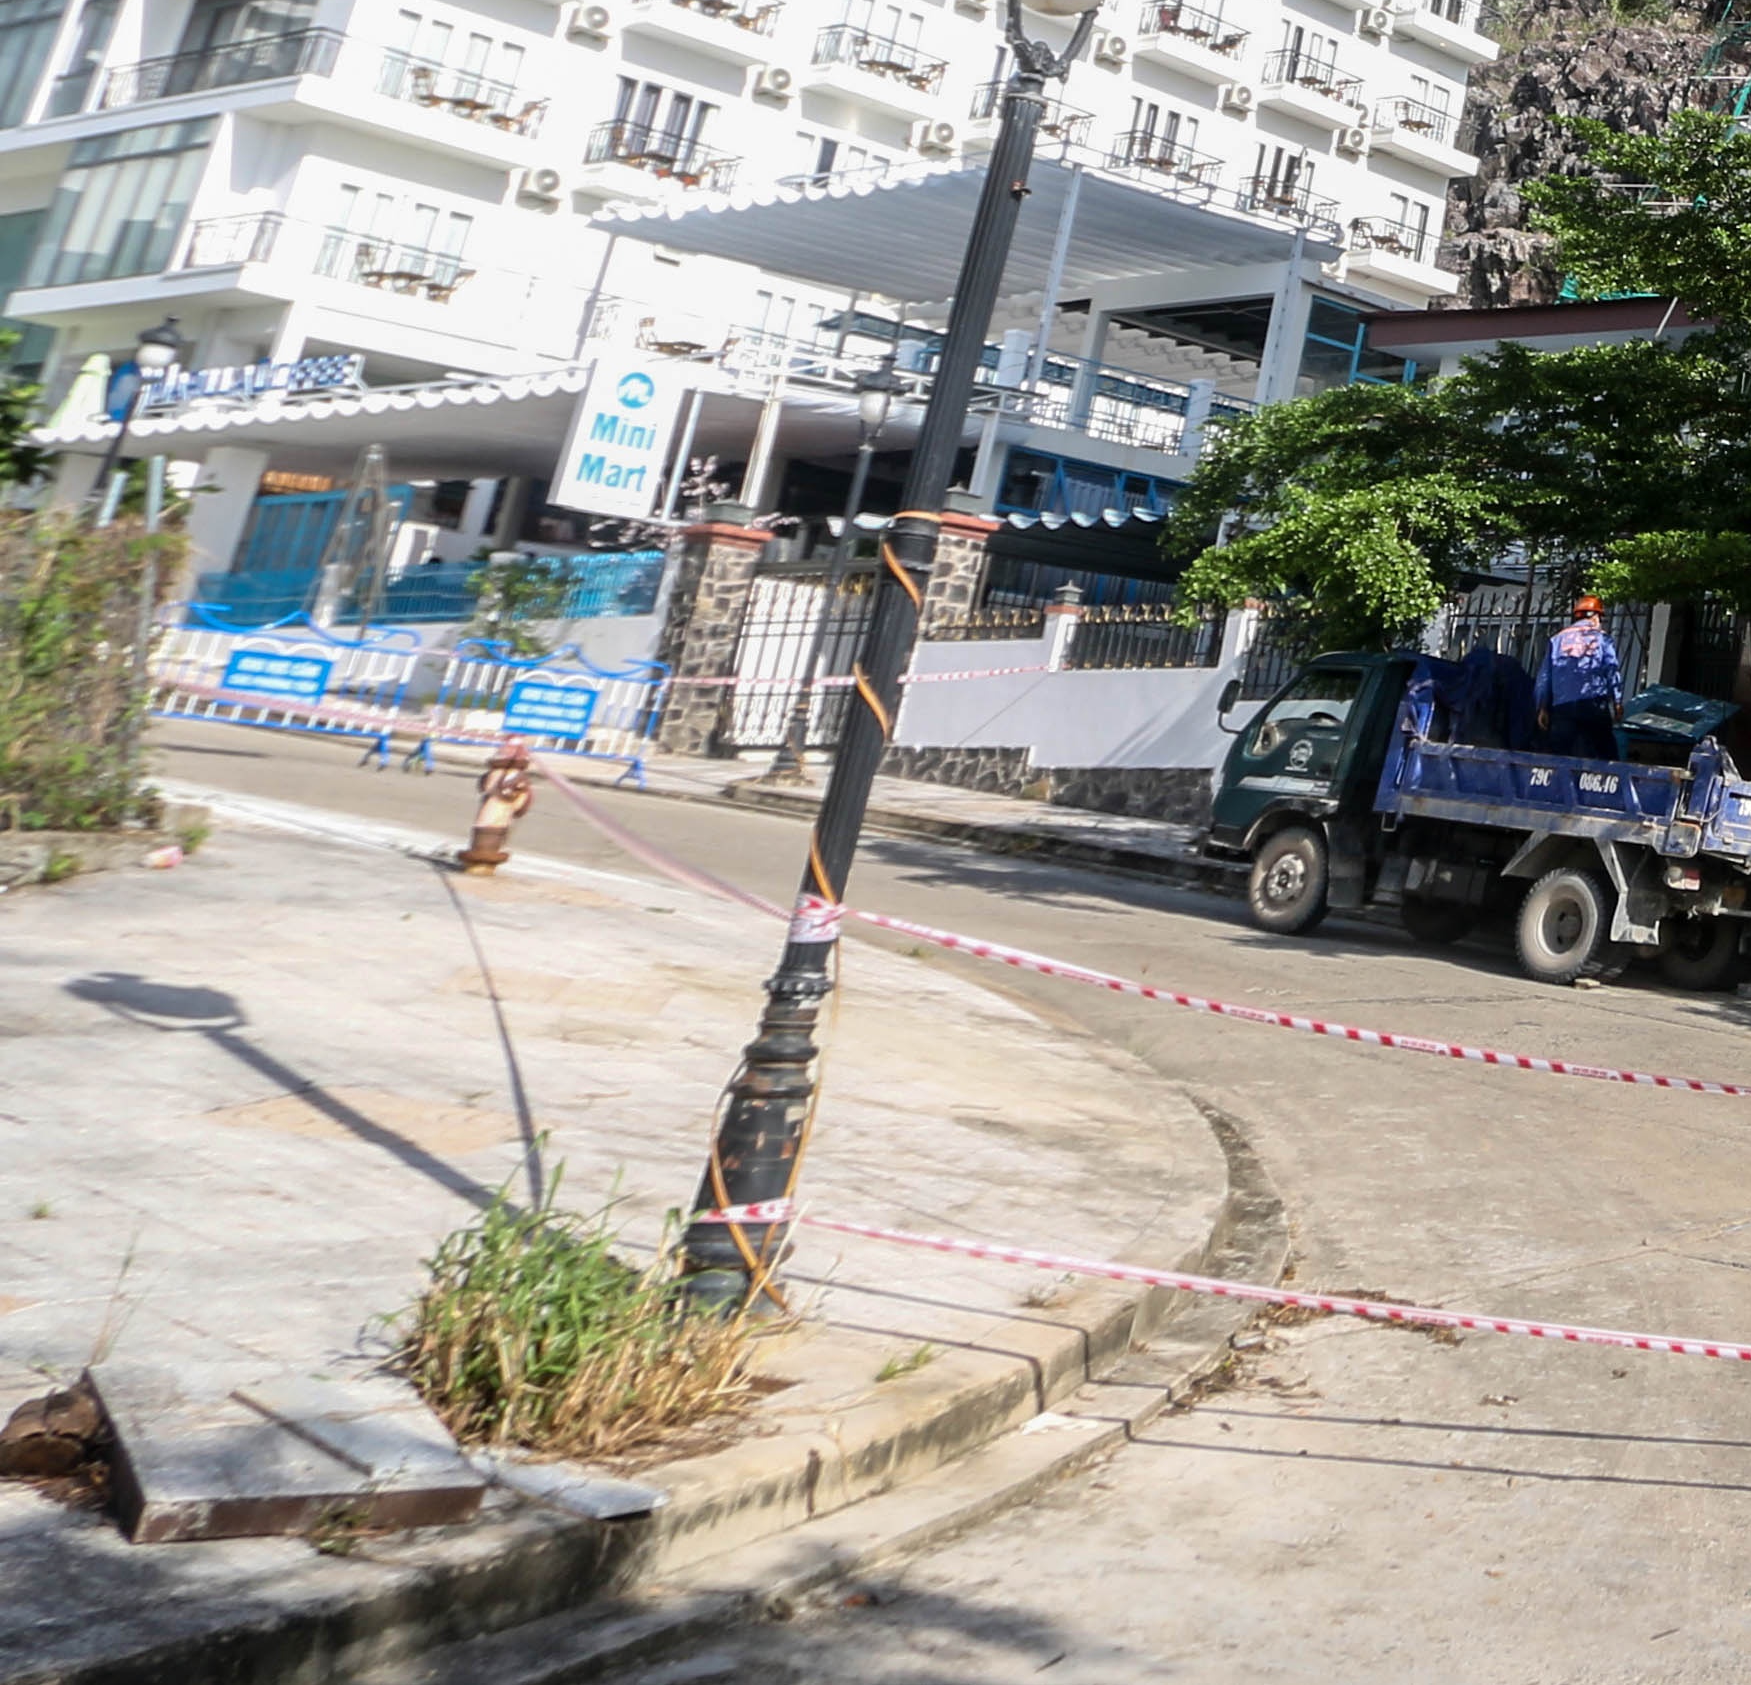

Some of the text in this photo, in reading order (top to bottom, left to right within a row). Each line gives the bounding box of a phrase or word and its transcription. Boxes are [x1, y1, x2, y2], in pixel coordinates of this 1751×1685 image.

[590, 412, 657, 451] Mini
[576, 453, 647, 492] Mart
[1530, 767, 1553, 787] 79C
